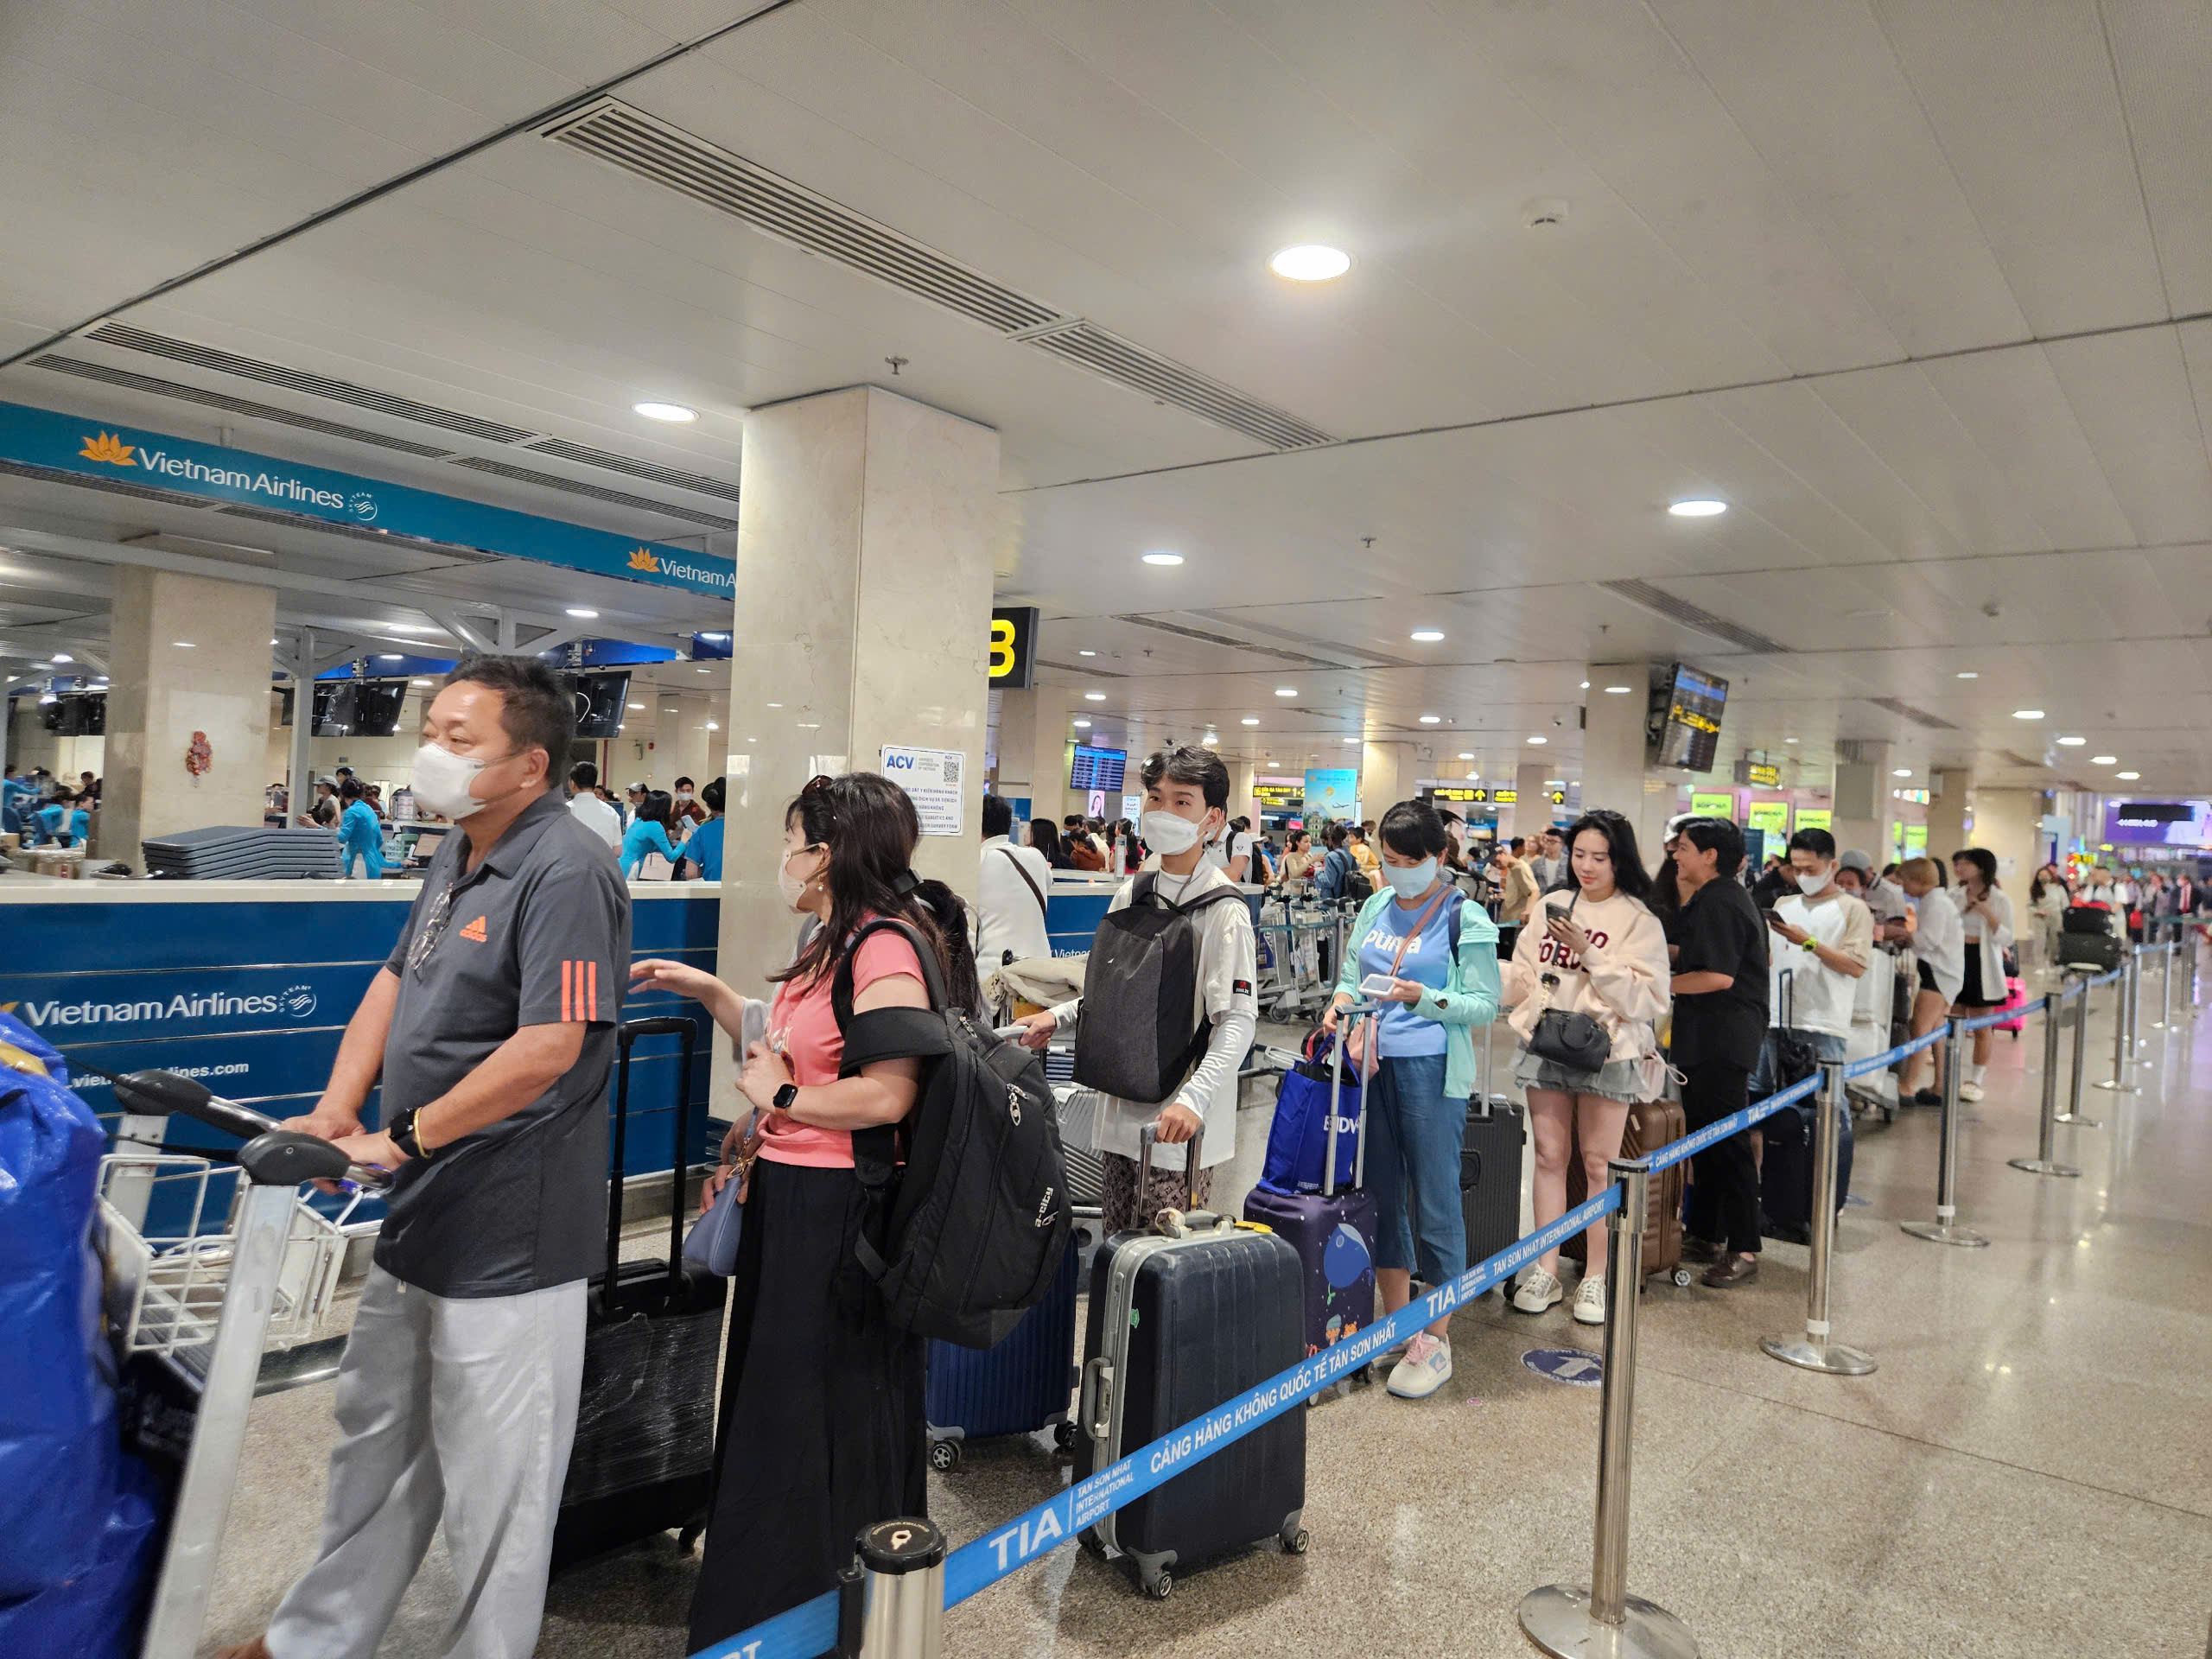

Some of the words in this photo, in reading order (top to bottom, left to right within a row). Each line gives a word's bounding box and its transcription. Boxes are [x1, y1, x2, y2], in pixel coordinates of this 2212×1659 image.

[138, 448, 251, 490] Vietnam
[252, 474, 345, 509] Airlines
[660, 557, 726, 588] Vietnam
[887, 755, 914, 769] ACV
[24, 995, 166, 1027] Vietnam
[164, 992, 278, 1020] Airlines
[1493, 1258, 1508, 1276] TAN
[1507, 1249, 1522, 1268] SON
[1522, 1238, 1540, 1259] NHAT
[1539, 1212, 1584, 1250] INTERNATIONAL
[1582, 1198, 1605, 1223] AIRPORT
[1427, 1285, 1456, 1319] TIA
[1151, 1440, 1192, 1473] CẢNG
[1194, 1413, 1232, 1451] HÀNG
[1234, 1389, 1277, 1427] KHÔNG
[1280, 1365, 1312, 1401] QUỐC
[1313, 1353, 1329, 1382] TẾ
[1329, 1348, 1349, 1374] TÂN
[1350, 1334, 1371, 1361] SƠN
[1372, 1316, 1396, 1350] NHẤT
[1076, 1471, 1135, 1513] INTERNATIONAL
[1077, 1481, 1093, 1499] TAN
[1094, 1471, 1110, 1489] SON
[1111, 1459, 1133, 1479] NHAT
[1076, 1498, 1111, 1528] AIRPORT
[988, 1506, 1064, 1571] TIA
